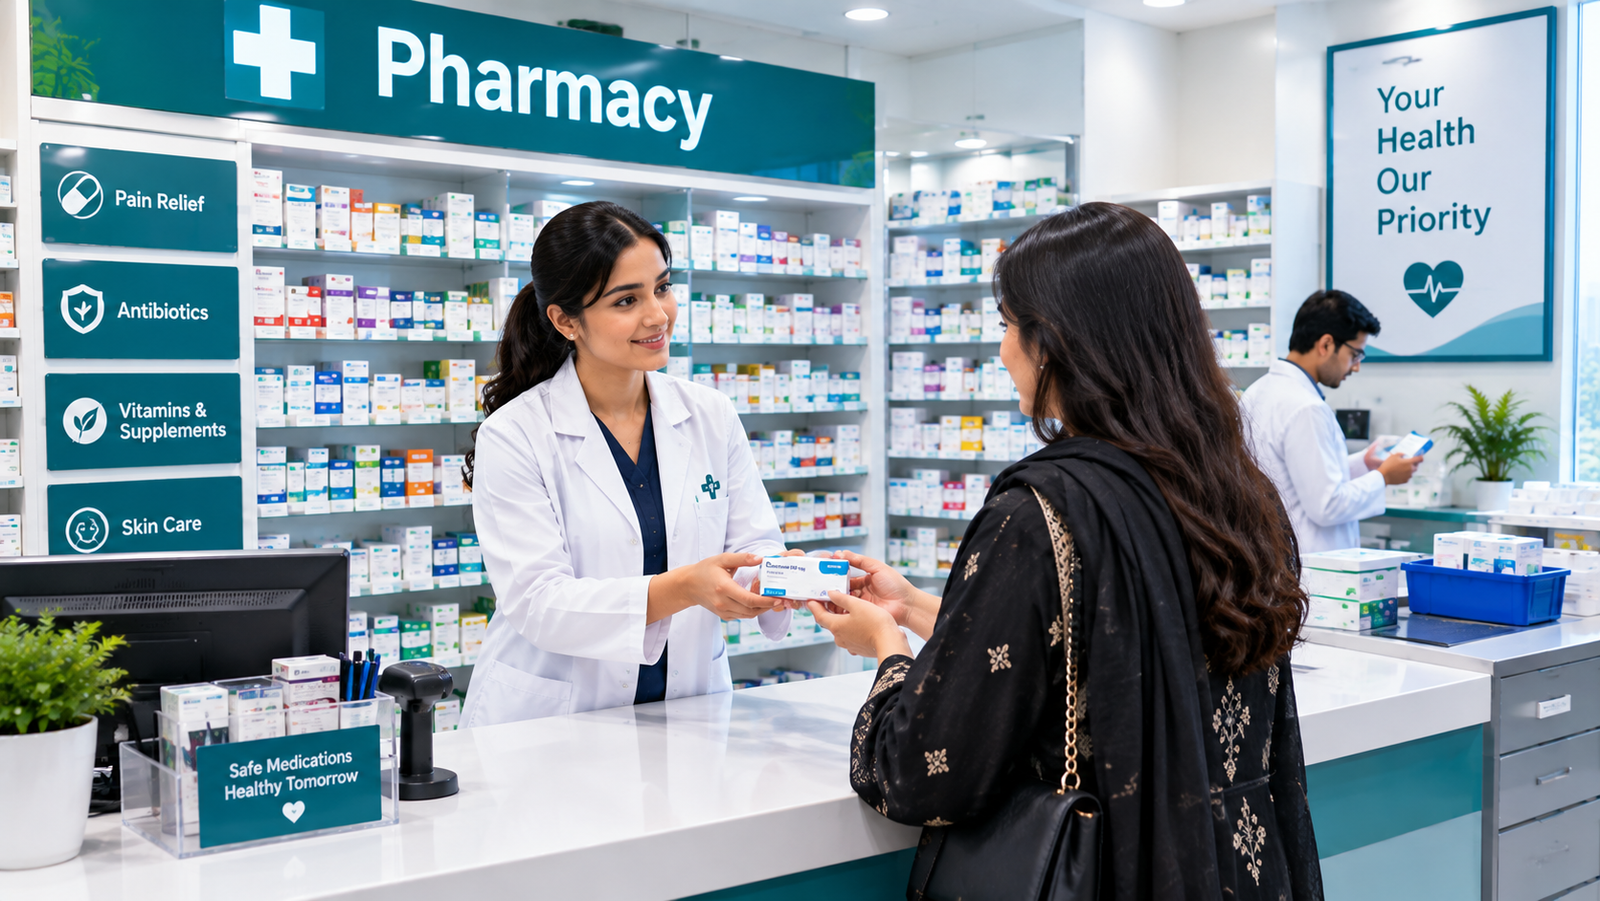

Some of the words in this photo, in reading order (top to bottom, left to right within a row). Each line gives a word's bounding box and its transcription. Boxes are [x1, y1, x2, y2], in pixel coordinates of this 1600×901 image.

[377, 26, 714, 151] Pharmacy
[1376, 85, 1445, 114] Your
[1377, 116, 1475, 155] Health
[1376, 167, 1432, 195] Our
[115, 189, 152, 209] Pain
[157, 192, 205, 212] Relief
[1377, 202, 1492, 236] Priority
[117, 301, 209, 321] Antibiotics
[118, 401, 191, 419] Vitamins
[195, 402, 208, 418] &
[120, 421, 227, 443] Supplements
[122, 517, 158, 536] Skin
[163, 516, 202, 533] Care
[229, 762, 263, 779] Safe
[266, 750, 353, 773] Medications
[224, 779, 283, 801] Healthy
[285, 770, 359, 791] Tomorrow
